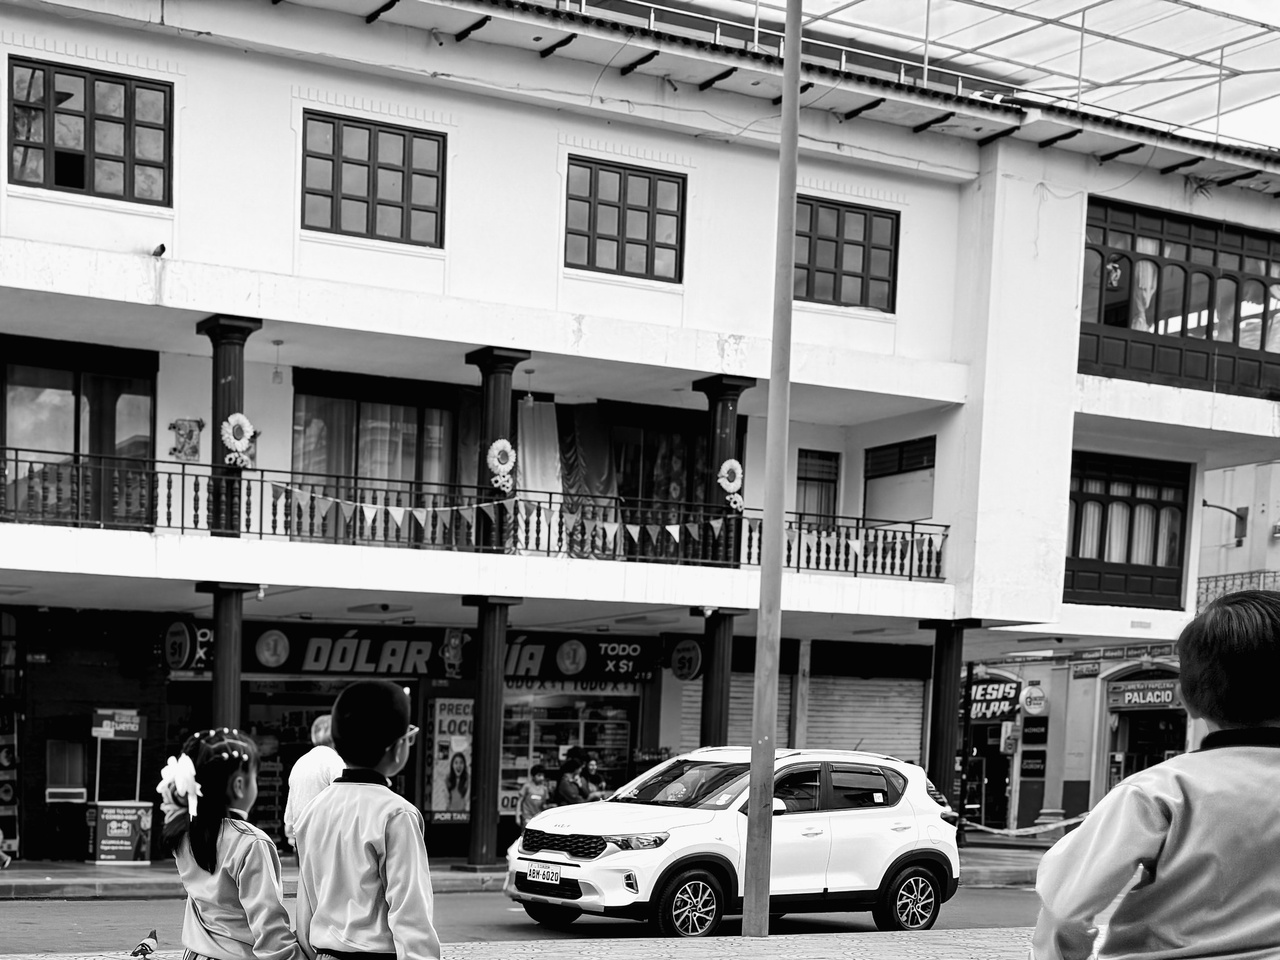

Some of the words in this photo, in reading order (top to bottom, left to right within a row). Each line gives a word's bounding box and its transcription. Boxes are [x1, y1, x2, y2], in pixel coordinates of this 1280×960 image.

[302, 630, 433, 674] DÓLAR
[598, 643, 642, 656] TODO
[605, 660, 617, 672] X
[619, 659, 634, 673] $1
[1124, 690, 1173, 704] PALACIO
[439, 703, 474, 716] PREC
[452, 812, 470, 821] TAN
